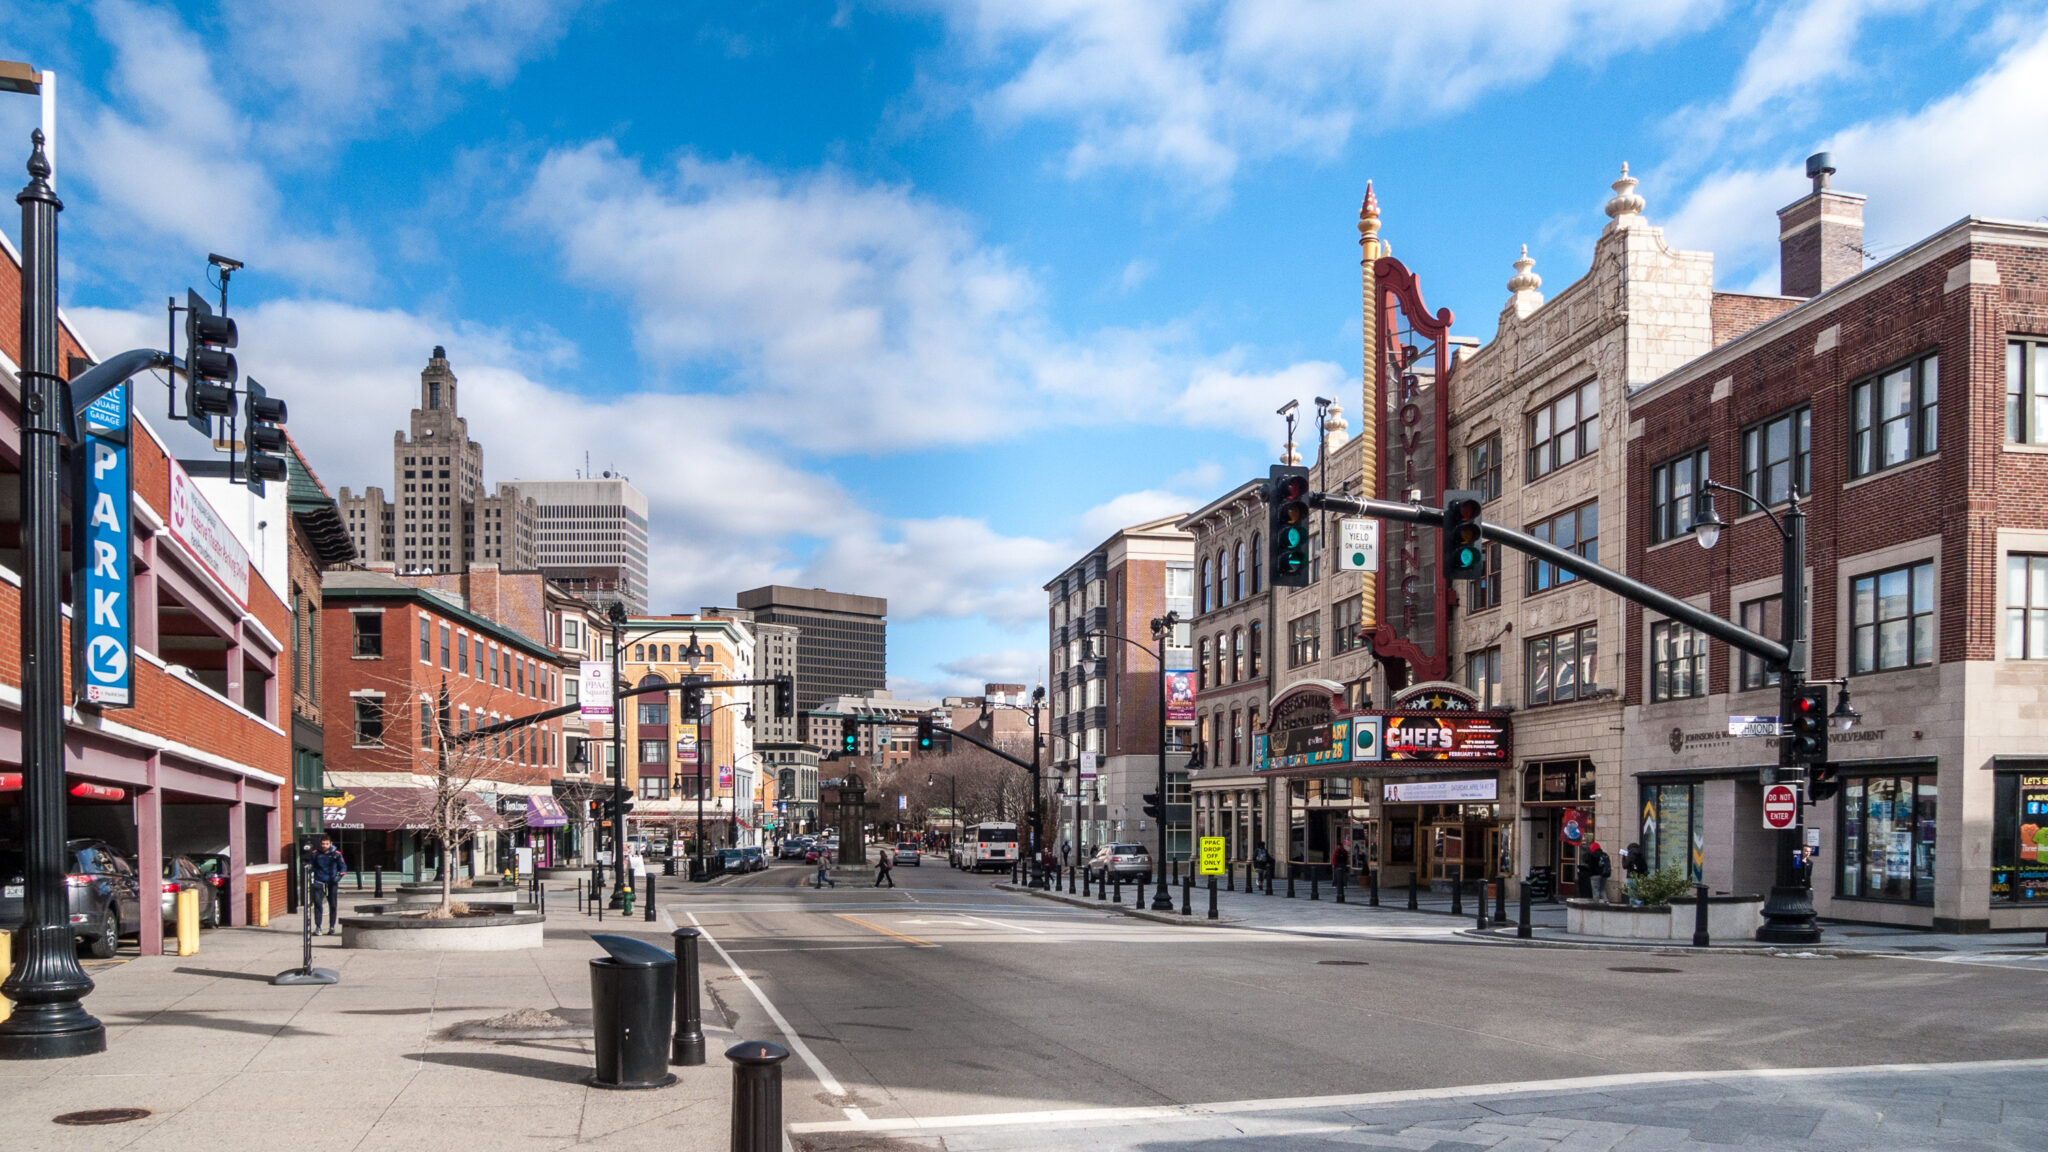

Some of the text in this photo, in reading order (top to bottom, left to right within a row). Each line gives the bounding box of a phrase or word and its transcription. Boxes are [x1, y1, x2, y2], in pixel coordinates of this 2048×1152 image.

[95, 400, 120, 413] QUARE
[90, 410, 120, 426] GARAGE
[90, 442, 121, 629] PARK
[1349, 532, 1369, 541] YIELD
[585, 681, 609, 689] PPAC
[1386, 728, 1453, 748] CHEFS
[1685, 731, 1714, 744] JOHNSON
[1715, 731, 1721, 739] &
[1828, 730, 1886, 743] NVOLVEMENT
[1685, 741, 1730, 749] UNIVERSITY
[323, 806, 347, 814] ZZA
[1770, 812, 1788, 820] ENTER
